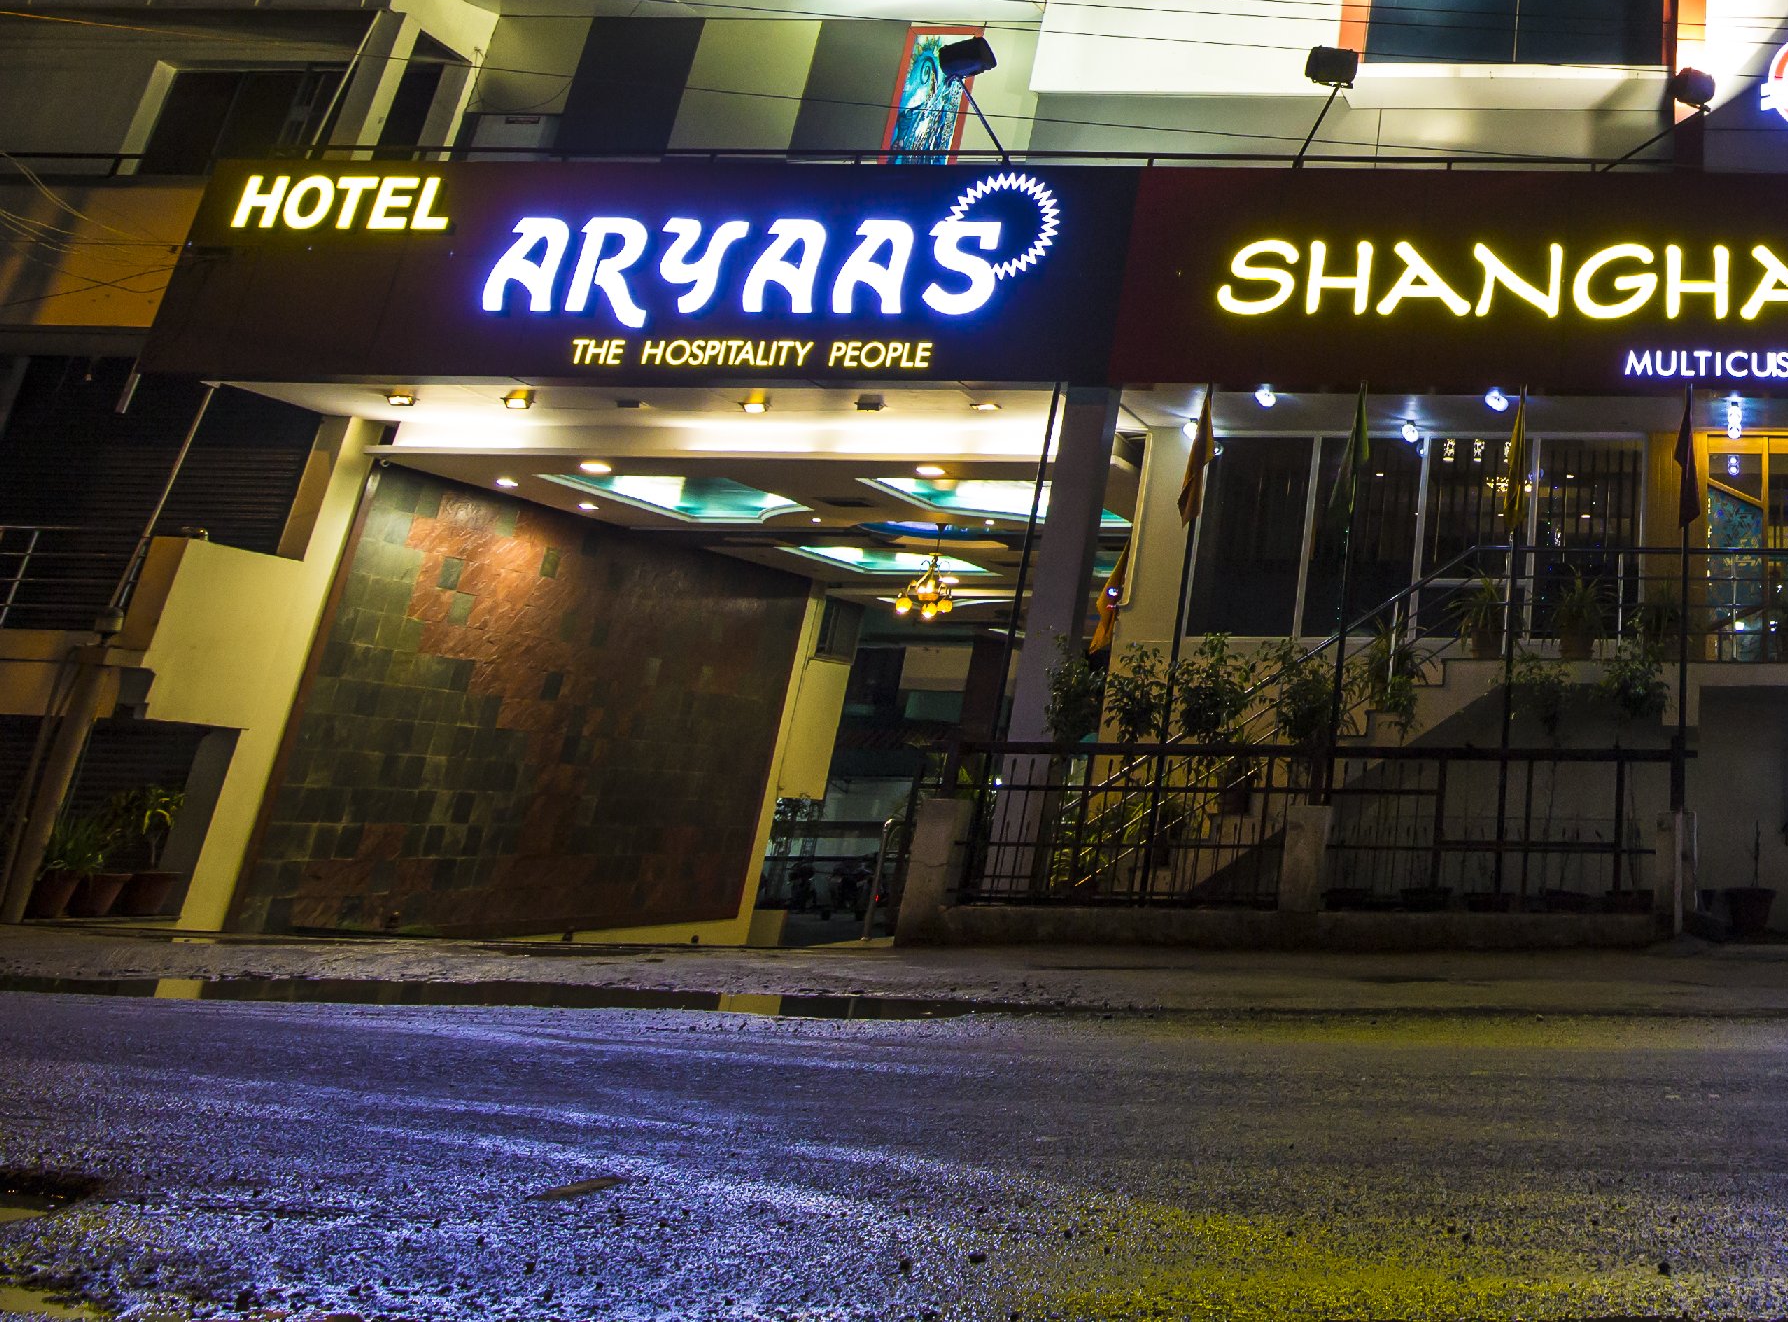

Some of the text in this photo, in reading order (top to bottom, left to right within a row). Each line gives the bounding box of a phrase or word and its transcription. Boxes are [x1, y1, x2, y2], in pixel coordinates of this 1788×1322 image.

[230, 174, 1003, 329] HOTEL ARYAAS
[572, 338, 934, 368] THE HOSPITALITY PEOPLE
